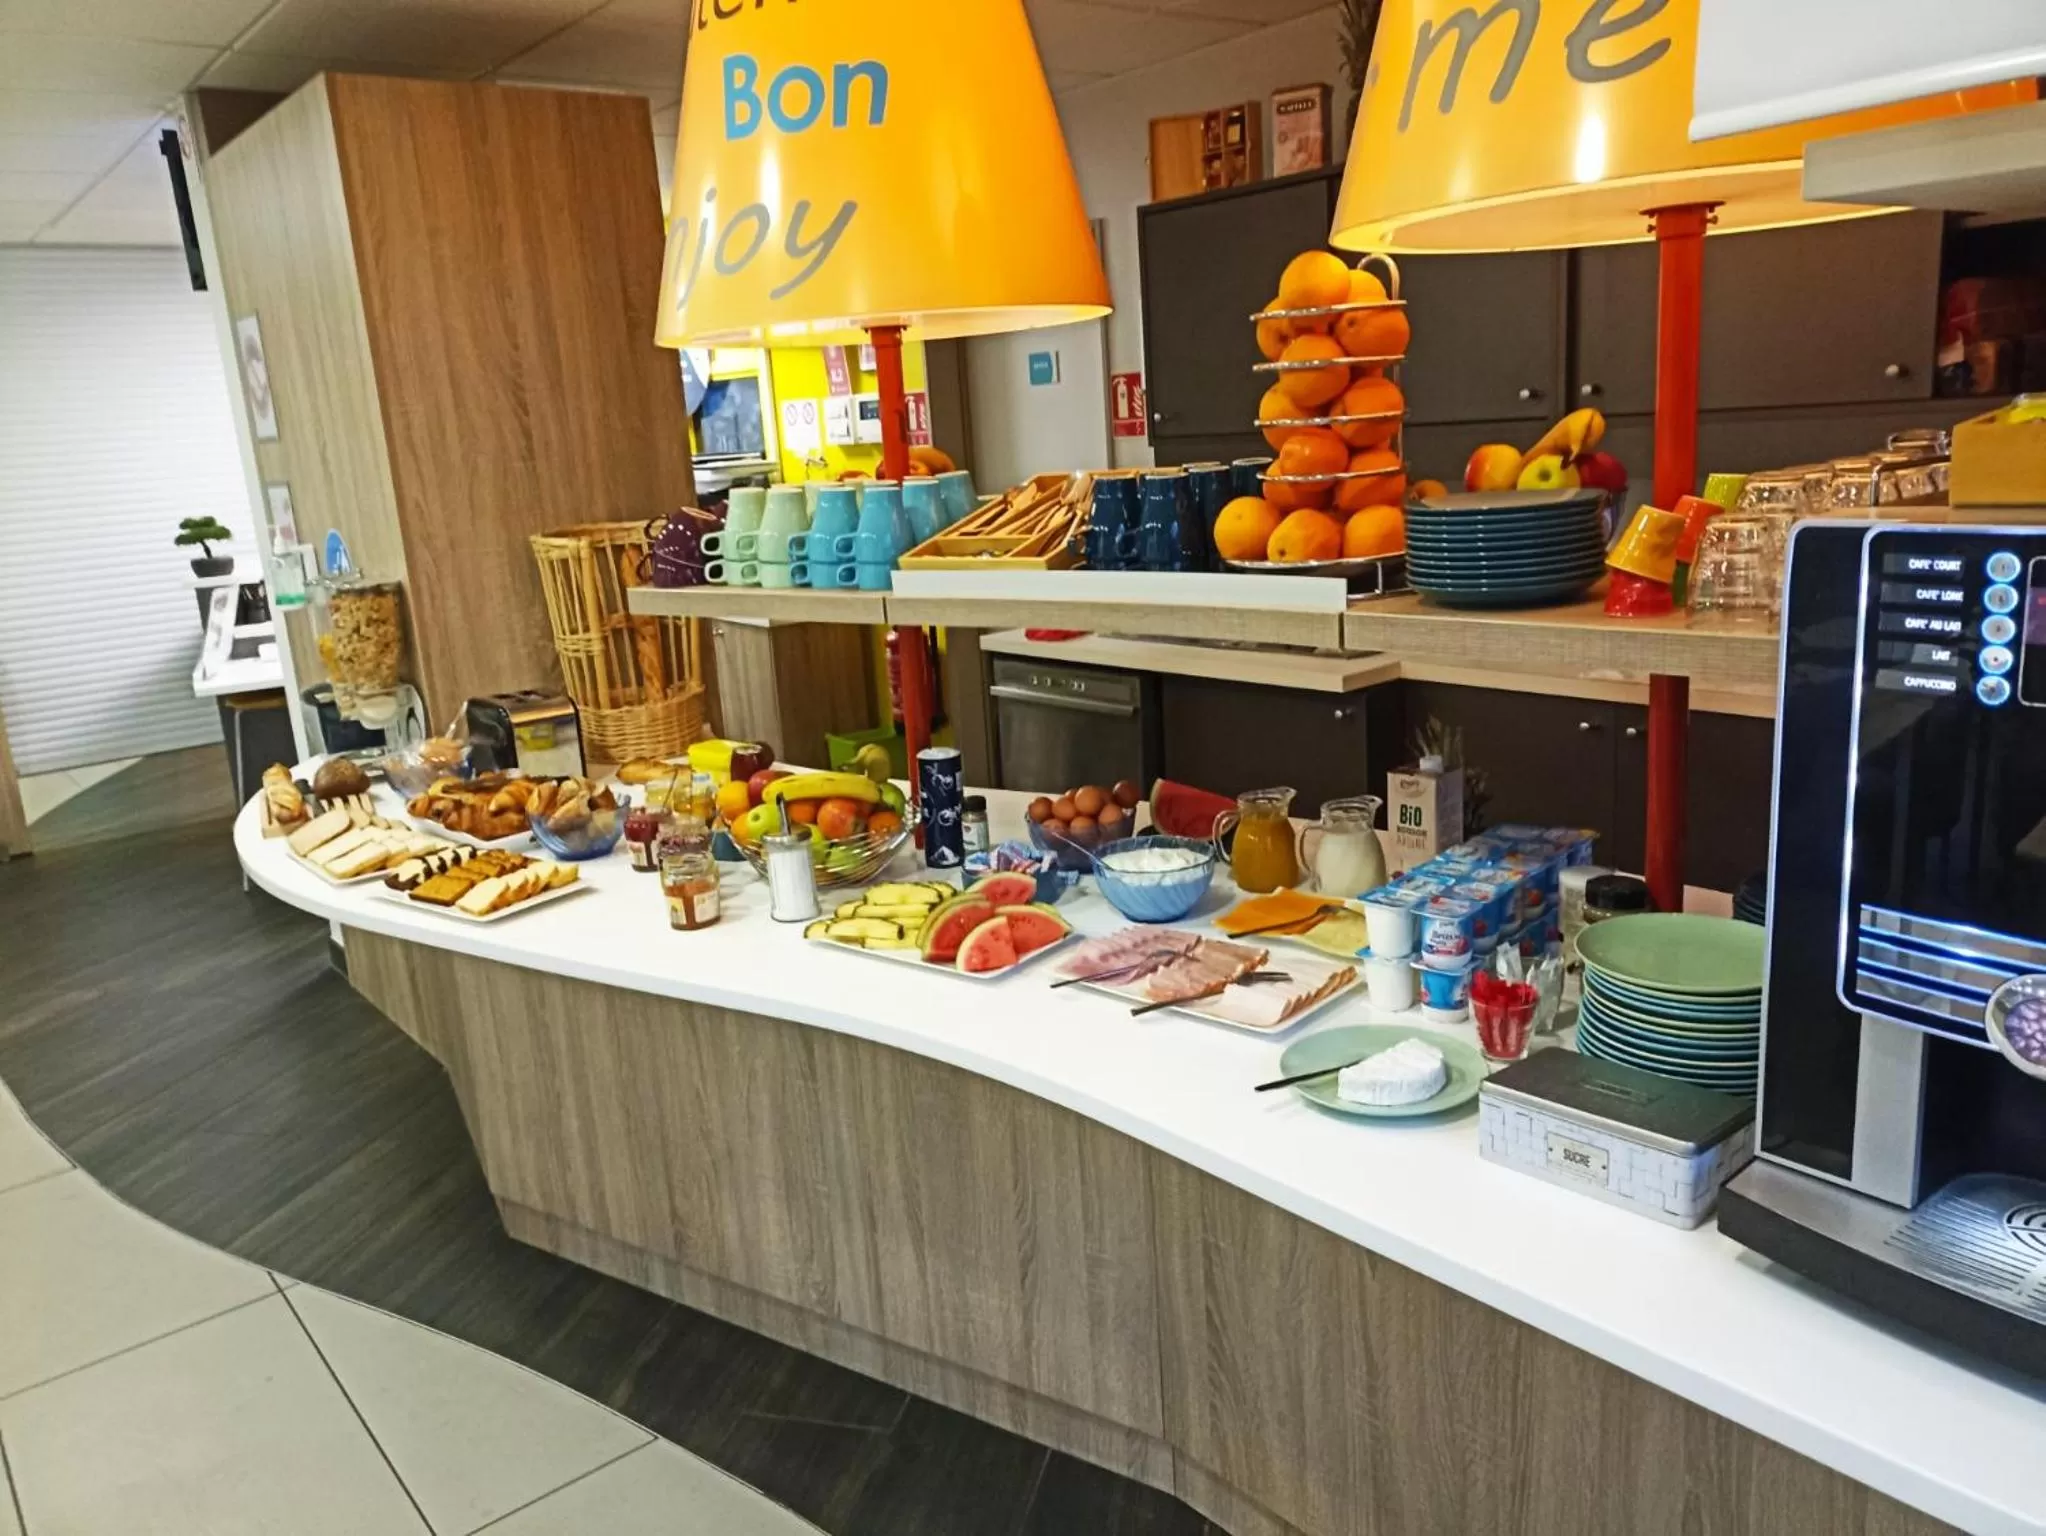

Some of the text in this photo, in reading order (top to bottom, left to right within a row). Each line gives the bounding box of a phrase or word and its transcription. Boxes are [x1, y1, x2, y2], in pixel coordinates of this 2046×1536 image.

[722, 53, 889, 141] Bon
[1368, 0, 1672, 133] me
[1563, 1148, 1591, 1168] SUCRE
